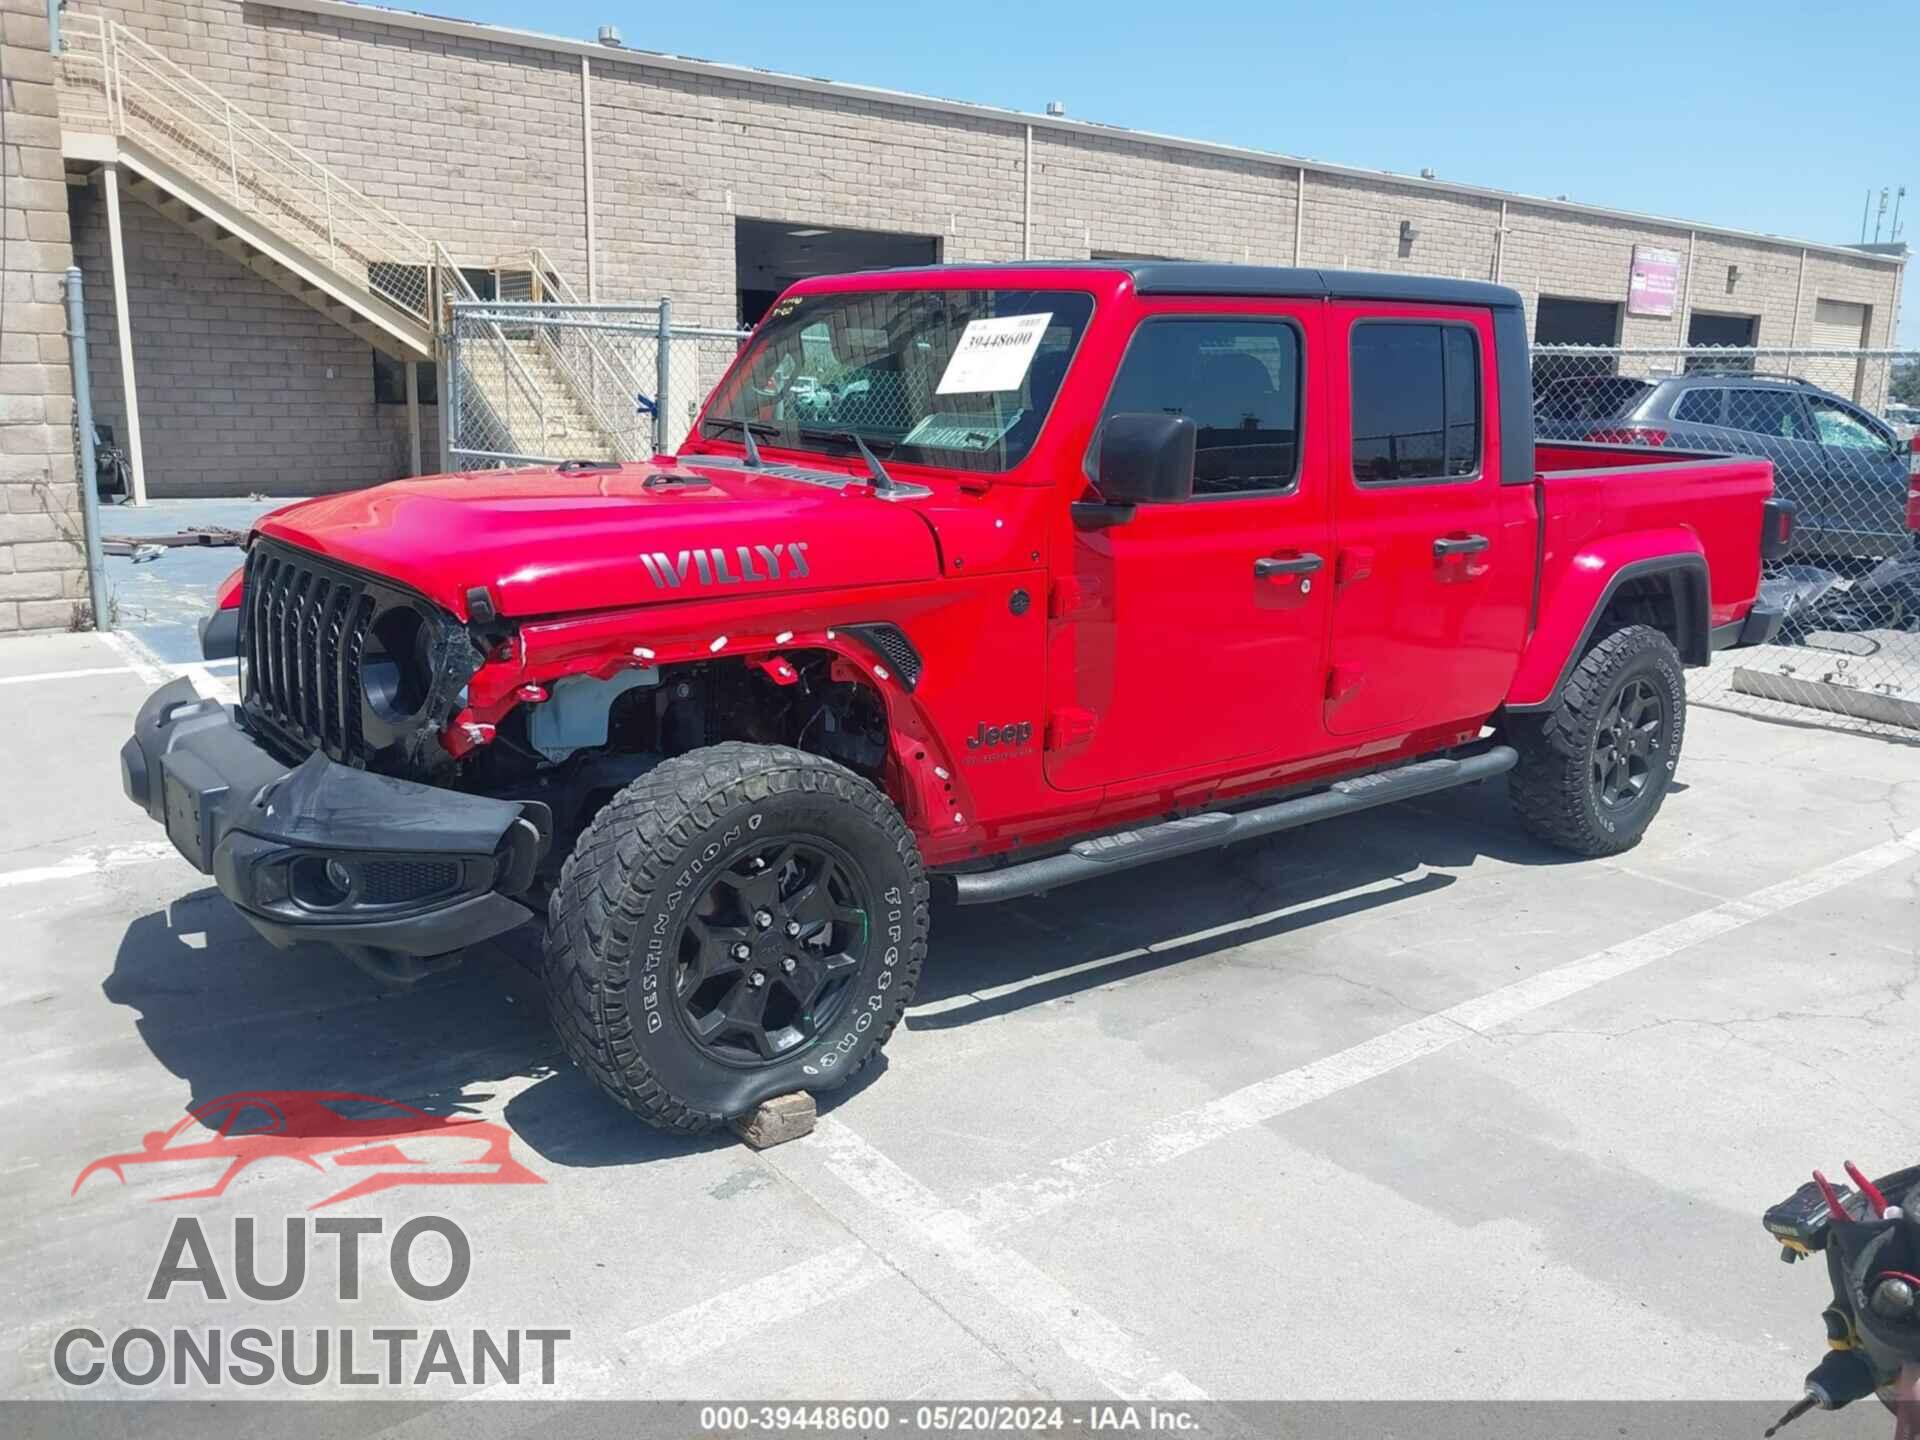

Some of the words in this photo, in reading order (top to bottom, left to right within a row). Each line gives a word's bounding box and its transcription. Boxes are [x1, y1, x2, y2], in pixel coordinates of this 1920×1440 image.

[967, 332, 1033, 348] 39448600
[639, 542, 810, 588] WILLYS
[966, 720, 1033, 750] Jeep
[643, 826, 741, 1034] DESTINATION
[819, 886, 902, 1068] Firestone
